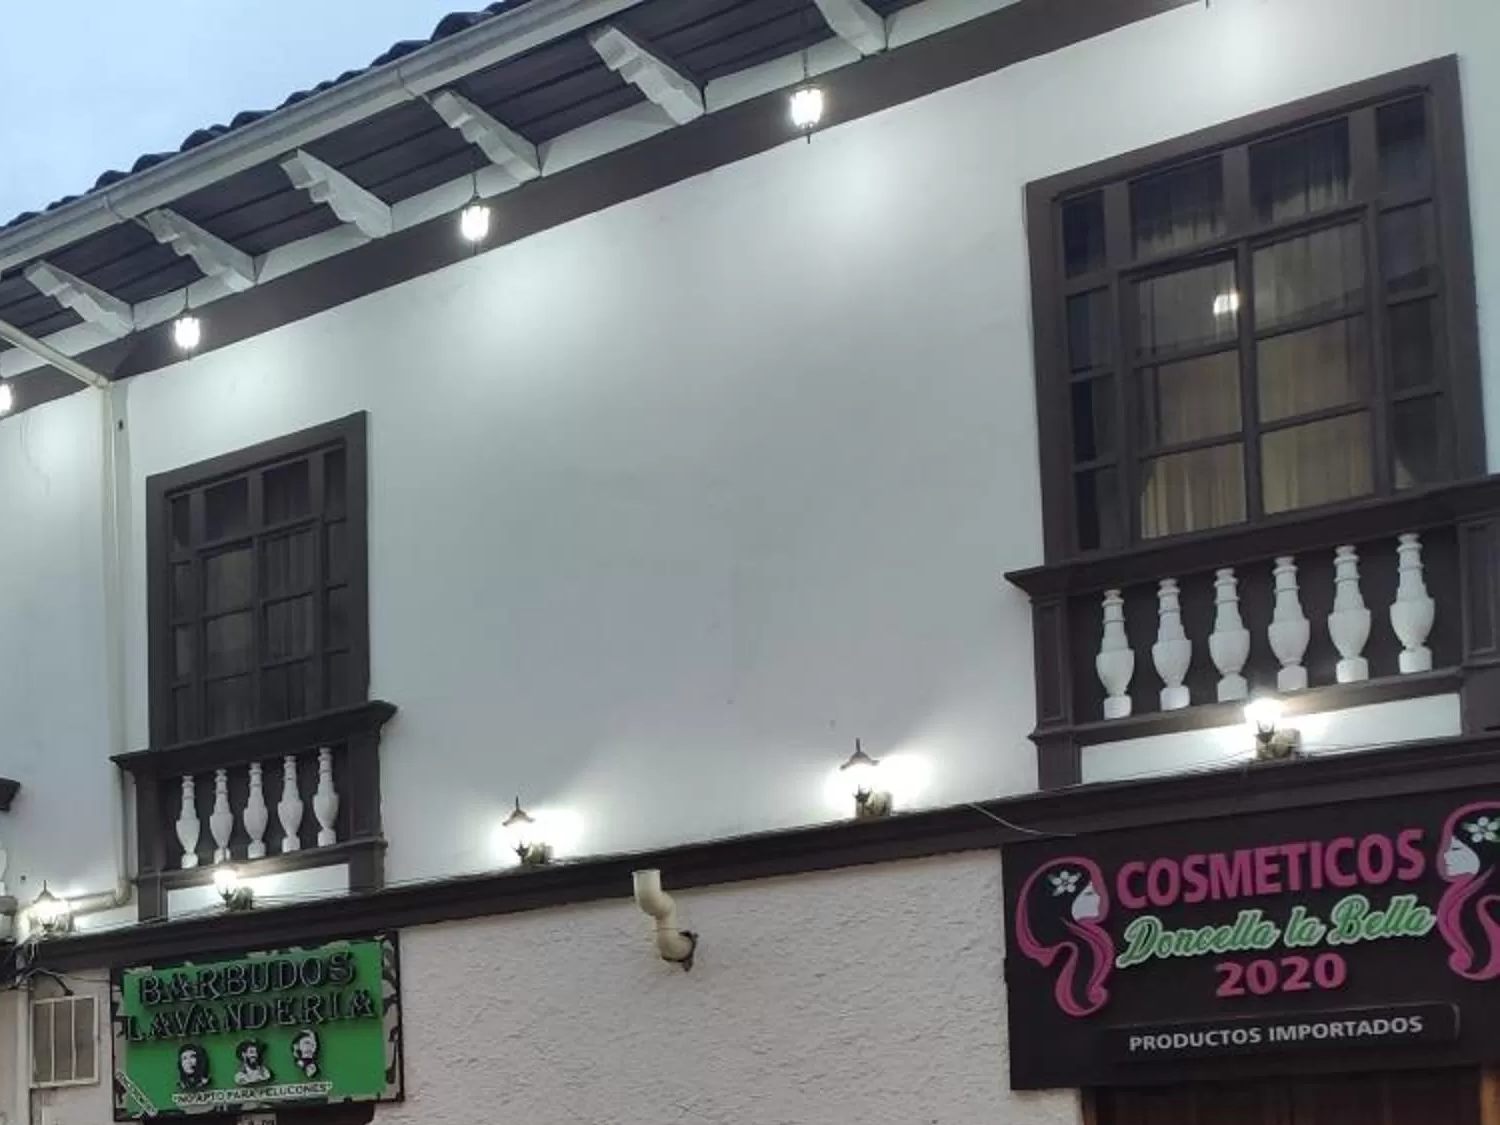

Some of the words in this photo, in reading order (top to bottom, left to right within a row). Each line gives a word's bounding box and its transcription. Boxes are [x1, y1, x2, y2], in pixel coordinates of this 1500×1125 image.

[1116, 828, 1426, 909] COSMETICOS
[1115, 908, 1281, 968] Doncella
[1284, 906, 1327, 949] la
[1328, 893, 1437, 945] Bella
[139, 951, 356, 1006] BARBUDOS
[1215, 952, 1348, 997] 2020
[122, 990, 378, 1043] LAVANDERIA
[1128, 1026, 1262, 1052] PRODUCTOS
[1267, 1015, 1423, 1042] IMPORTADOS
